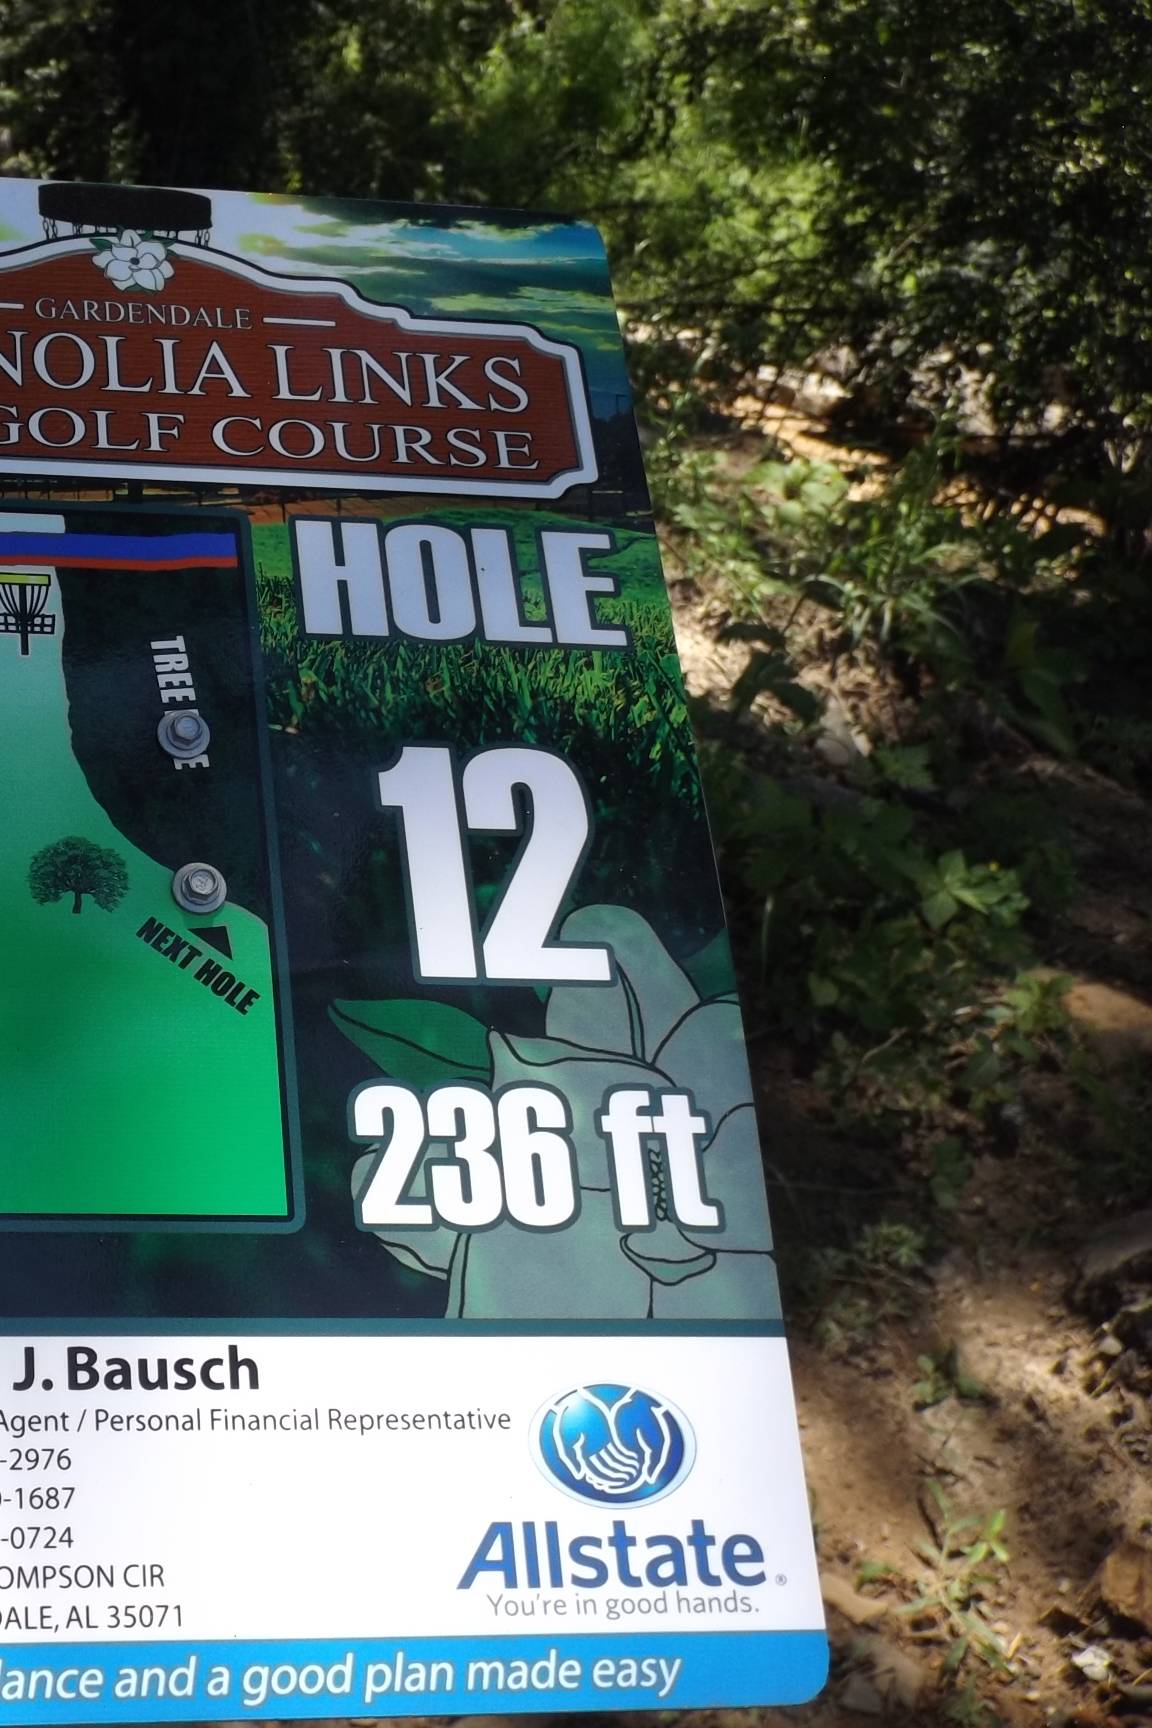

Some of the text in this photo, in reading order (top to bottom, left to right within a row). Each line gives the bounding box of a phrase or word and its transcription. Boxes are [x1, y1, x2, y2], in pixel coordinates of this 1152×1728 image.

[34, 296, 253, 331] GARDENDALE
[274, 346, 530, 414] LINKS
[211, 417, 541, 472] COURSE
[291, 518, 629, 647] HOLE
[150, 635, 196, 703] TREE
[377, 745, 614, 981] 12
[136, 916, 261, 1015] NEXT HOLE
[353, 1085, 720, 1227] 236 ft
[12, 1346, 54, 1391] J.
[68, 1344, 260, 1391] Bausch
[94, 1407, 201, 1432] Personal
[210, 1407, 319, 1432] Financial
[328, 1407, 511, 1436] Representative
[123, 1563, 165, 1589] CIR
[456, 1519, 767, 1589] Allstate
[65, 1604, 99, 1630] AL
[107, 1604, 182, 1629] 35071
[486, 1589, 760, 1620] You're in good hands.
[114, 1654, 198, 1700] and
[206, 1664, 232, 1698] a
[243, 1651, 355, 1708] good
[363, 1650, 455, 1705] plan
[466, 1648, 583, 1693] made
[591, 1657, 683, 1699] easy
